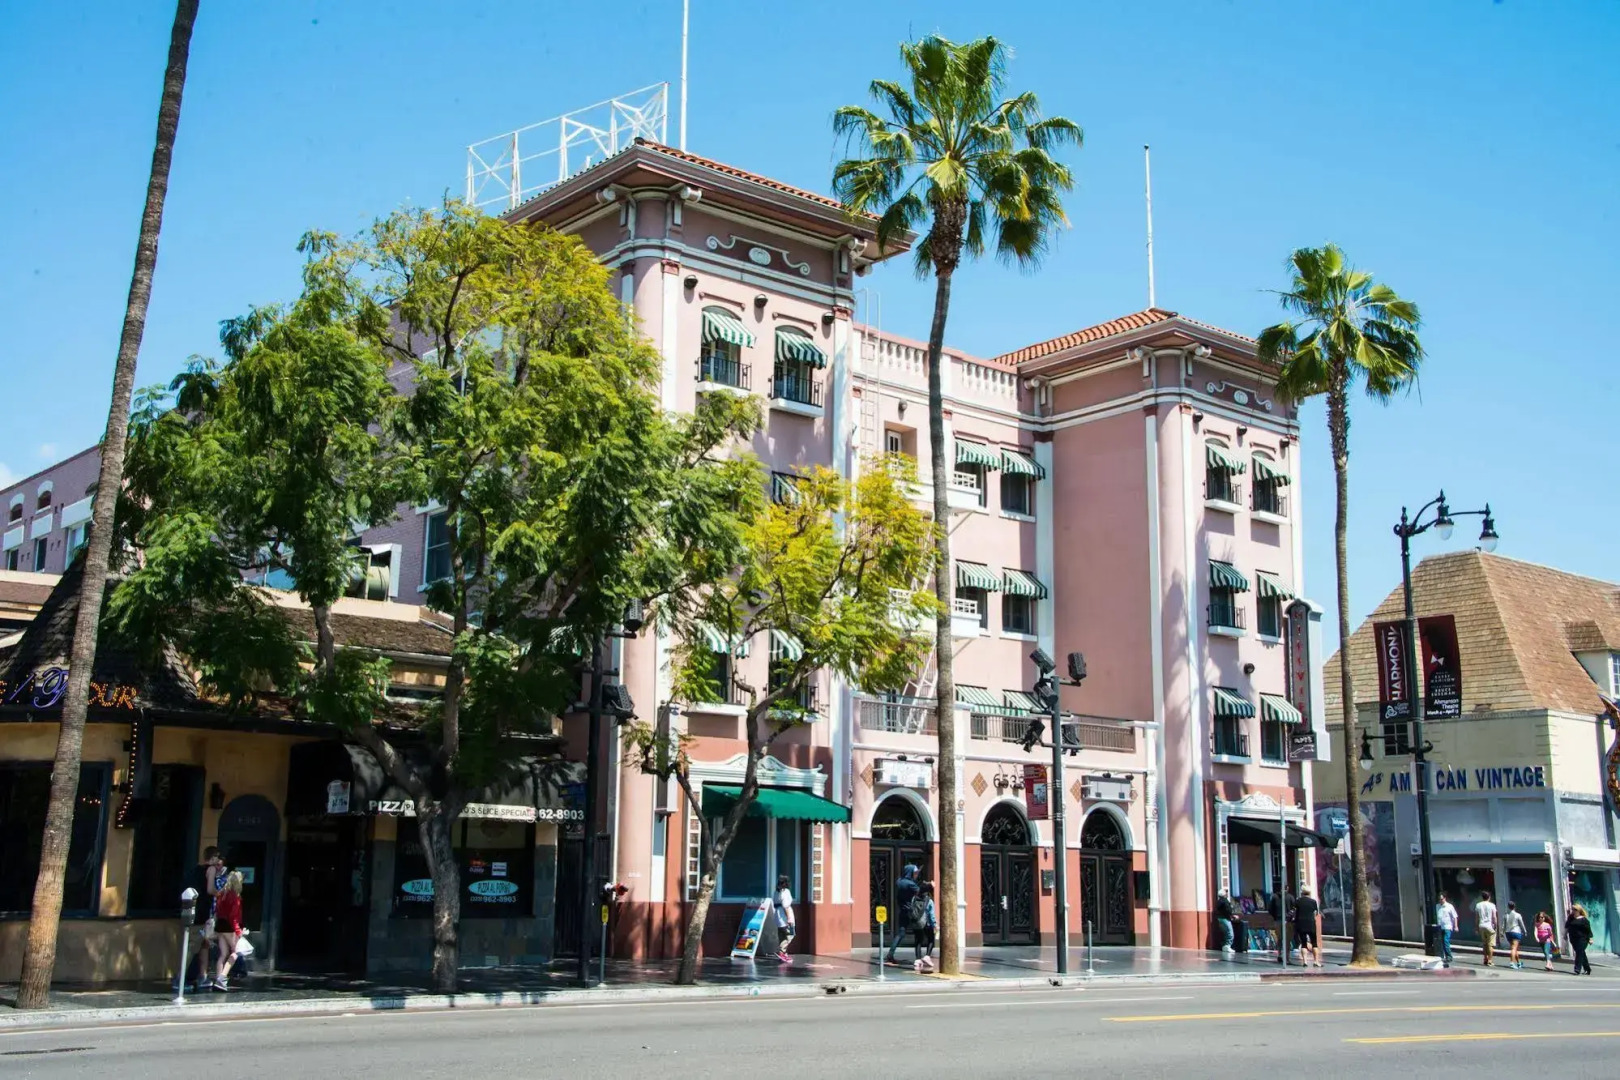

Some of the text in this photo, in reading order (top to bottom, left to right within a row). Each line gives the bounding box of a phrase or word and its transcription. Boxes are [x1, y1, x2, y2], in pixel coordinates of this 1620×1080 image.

[1388, 625, 1402, 701] HARMONY
[1390, 768, 1467, 792] AMCAN
[1475, 766, 1545, 789] VINTAGE
[478, 807, 499, 815] SLICE
